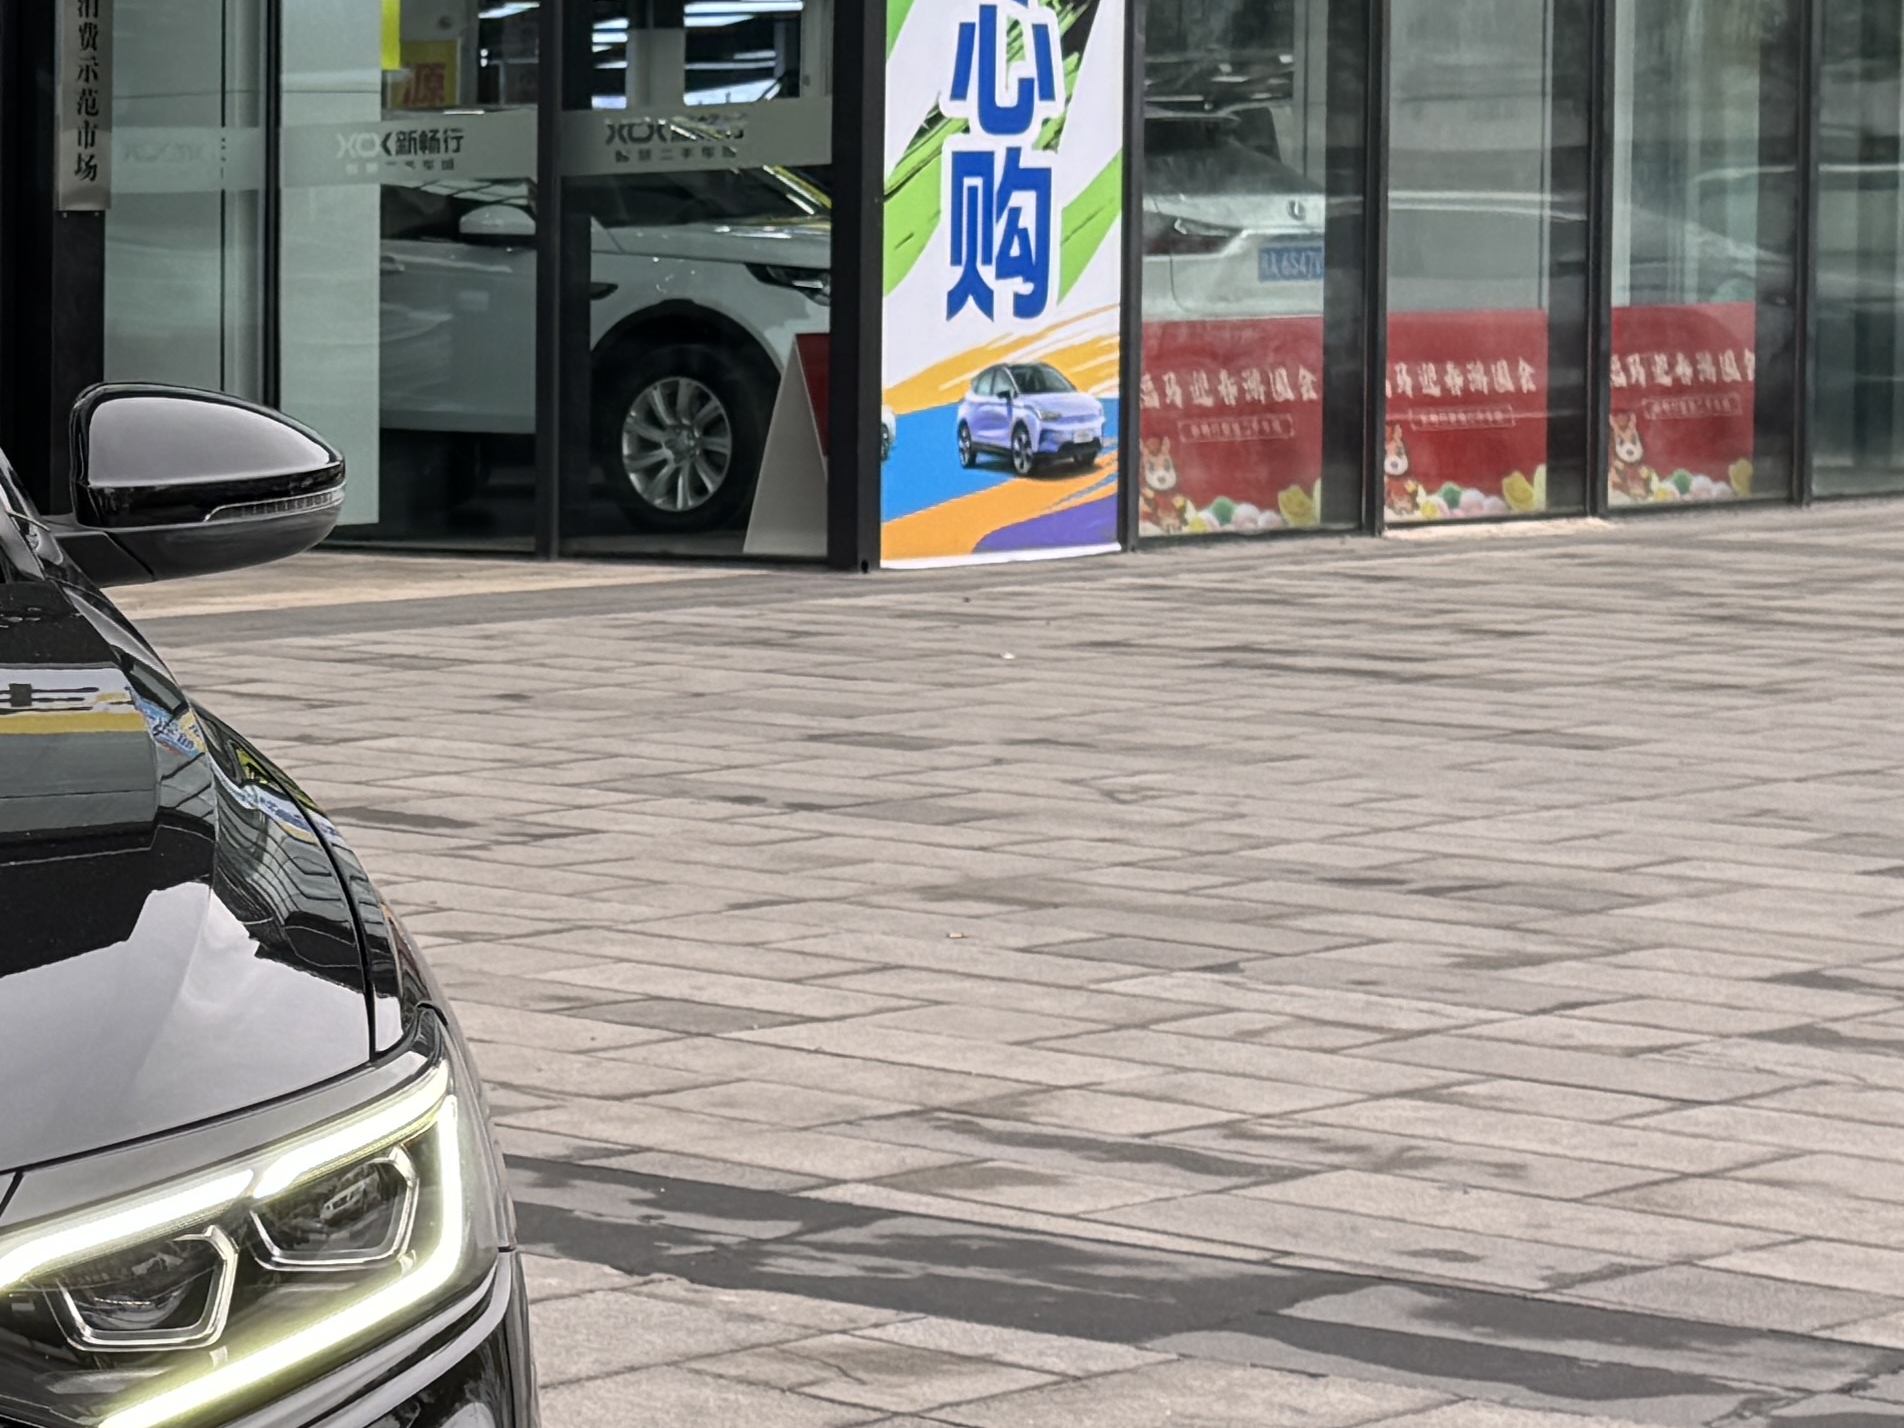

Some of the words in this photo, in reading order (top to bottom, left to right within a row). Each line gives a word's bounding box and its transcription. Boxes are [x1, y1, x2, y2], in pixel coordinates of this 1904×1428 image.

[395, 128, 465, 155] 新畅行
[1386, 357, 1537, 397] 马迎春游园会
